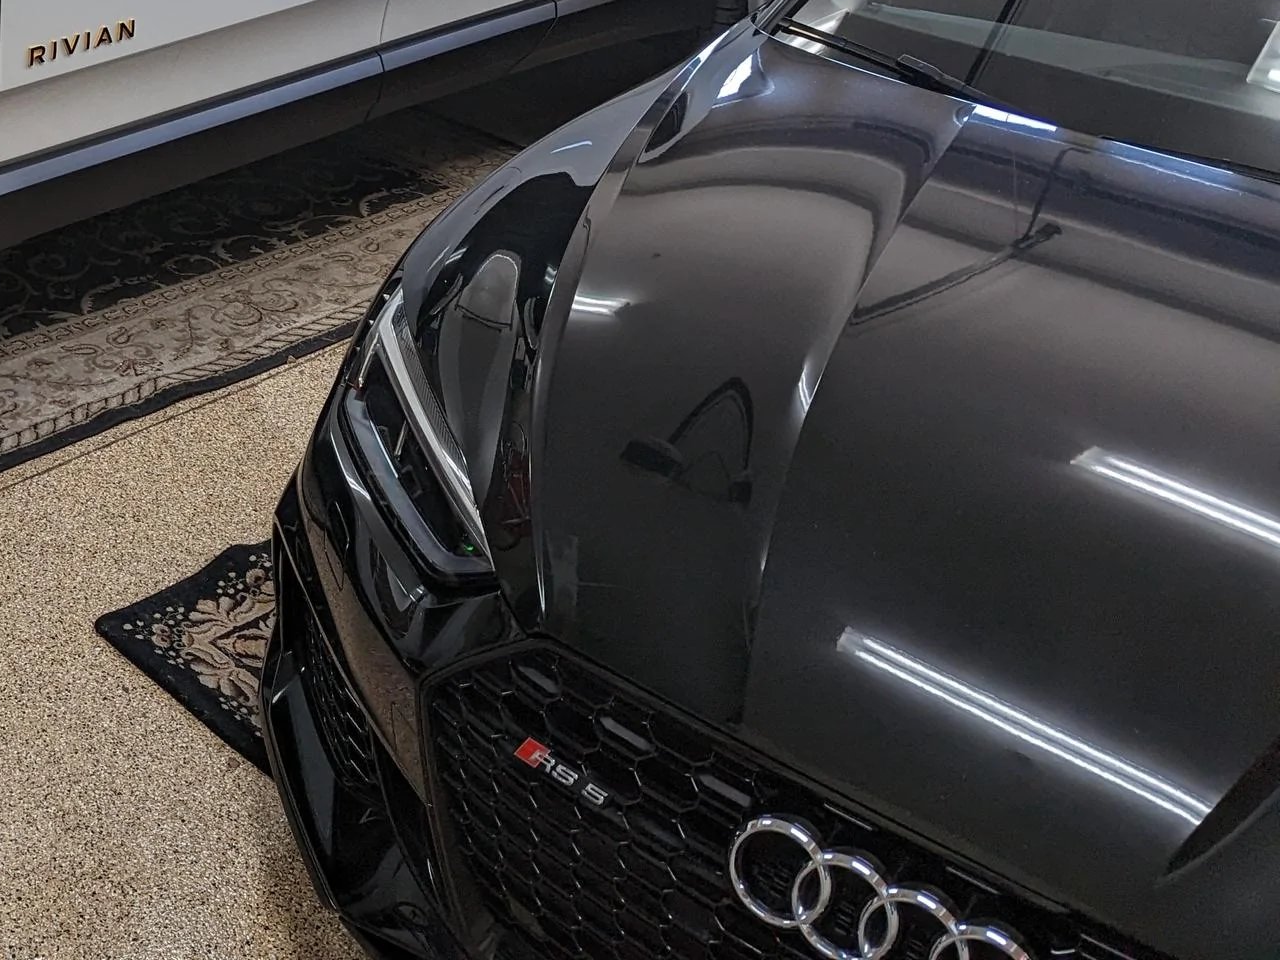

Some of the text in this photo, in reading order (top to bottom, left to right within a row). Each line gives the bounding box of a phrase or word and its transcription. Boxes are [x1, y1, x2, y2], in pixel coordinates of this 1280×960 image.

[26, 19, 136, 68] RIVIAN
[527, 749, 609, 806] RS 5
